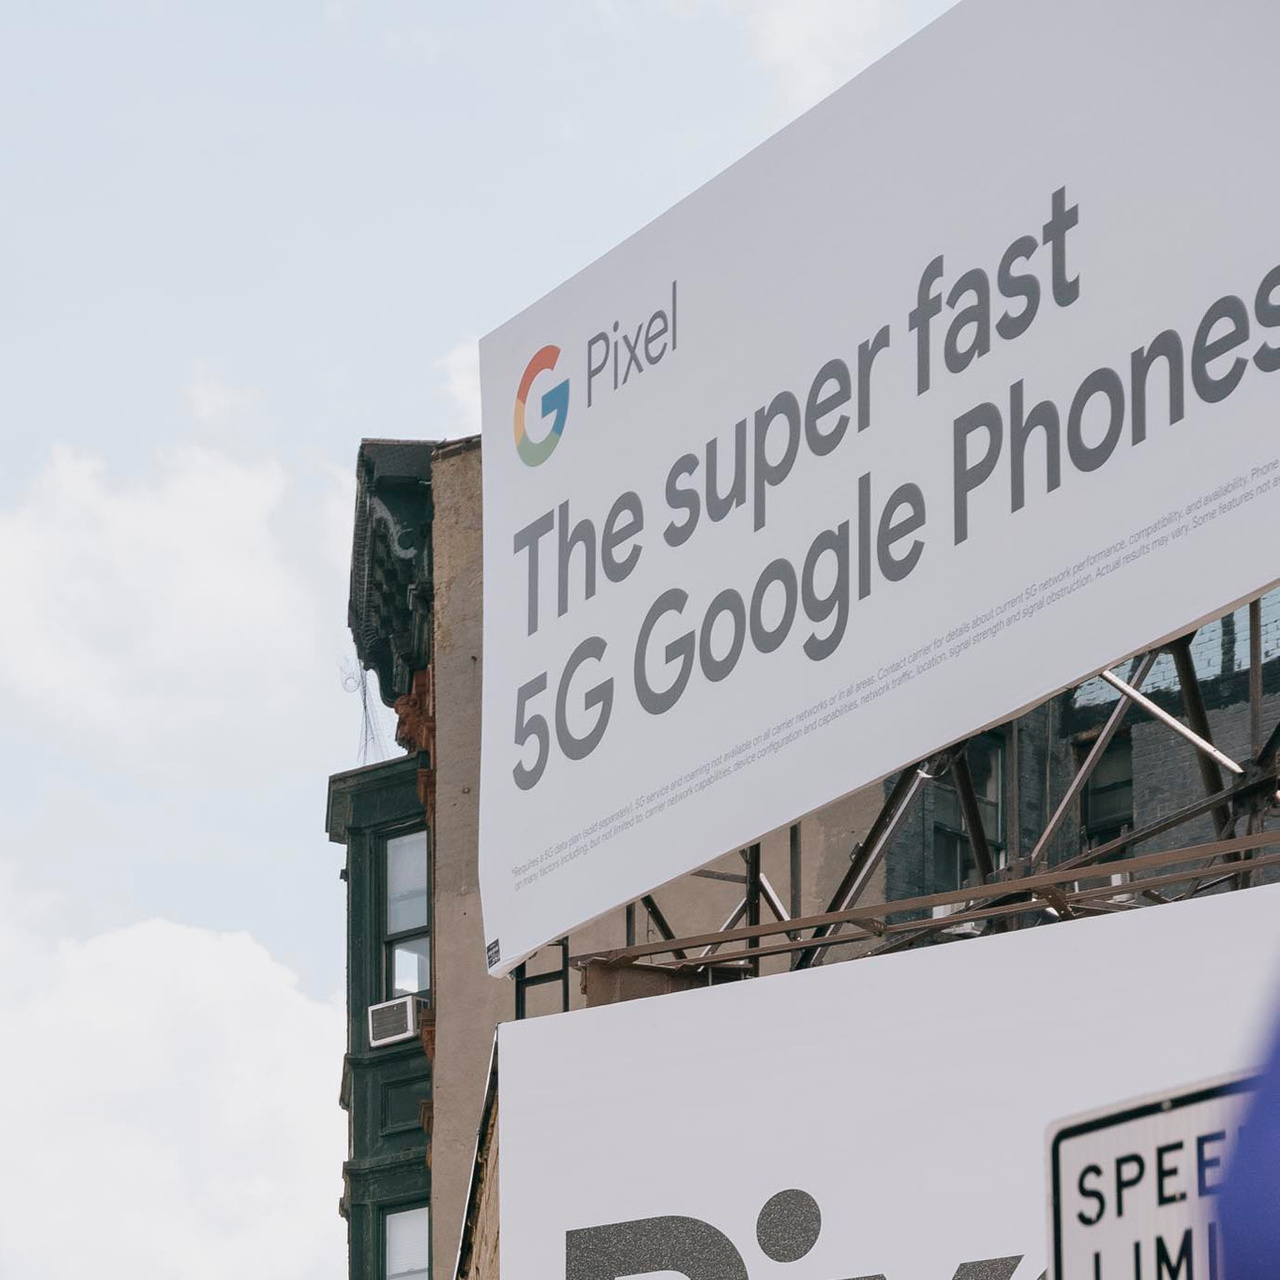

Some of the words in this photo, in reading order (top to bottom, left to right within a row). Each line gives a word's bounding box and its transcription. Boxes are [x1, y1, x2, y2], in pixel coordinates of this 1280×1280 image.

[513, 490, 643, 638] The
[663, 323, 891, 547] super
[909, 186, 1081, 396] fast
[587, 280, 677, 408] Pixel
[512, 635, 614, 791] 5G
[633, 472, 926, 716] Google
[953, 263, 1280, 546] Phones
[1078, 1130, 1226, 1226] SPEE
